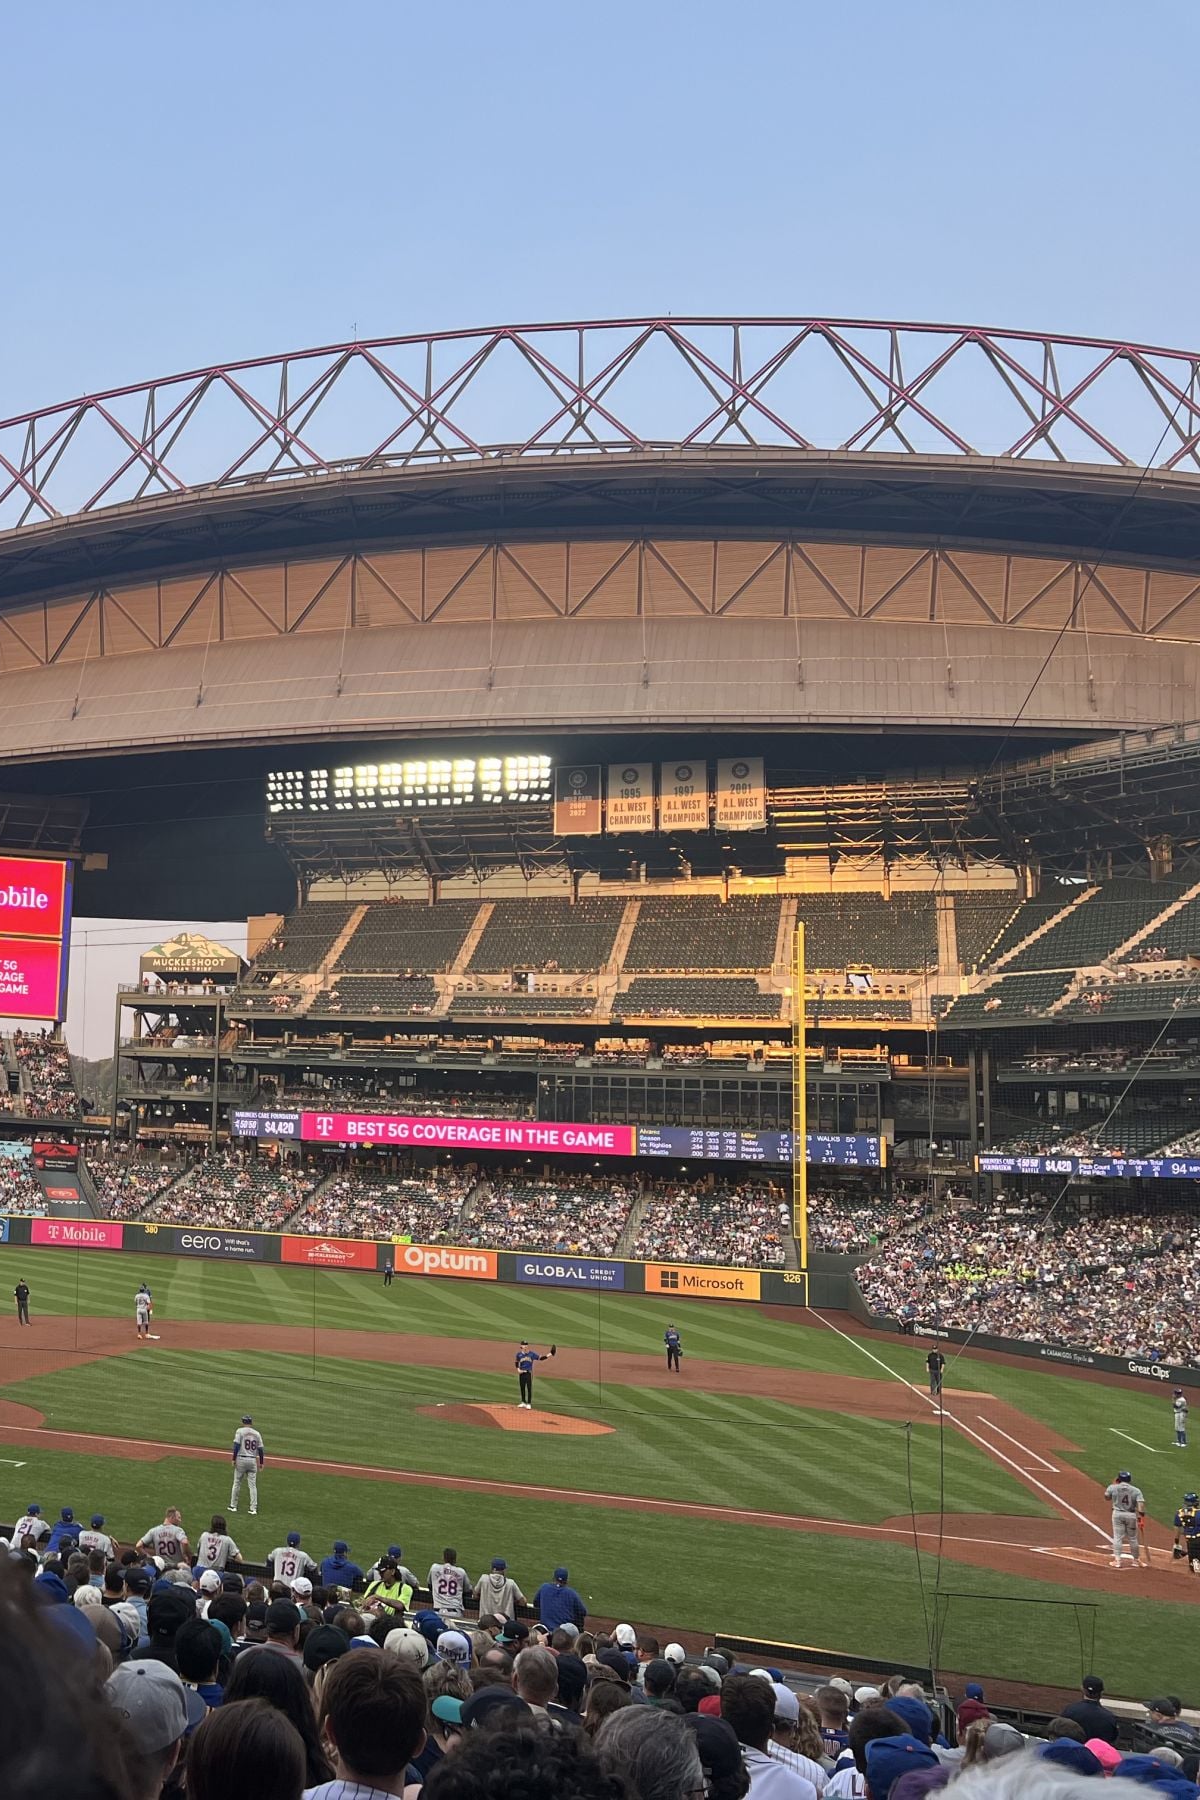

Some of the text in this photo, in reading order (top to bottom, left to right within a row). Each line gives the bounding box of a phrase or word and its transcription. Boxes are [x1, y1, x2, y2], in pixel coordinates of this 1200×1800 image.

[620, 788, 641, 799] 1995
[674, 786, 695, 798] 1997
[613, 802, 647, 812] A.L. WEST
[667, 799, 701, 810] A.L. WEST
[723, 797, 758, 808] A.L. WEST
[609, 814, 651, 825] CHAMPIONS
[662, 813, 706, 823] CHAMPIONS
[718, 810, 763, 821] CHAMPIONS
[2, 960, 17, 971] 5G
[152, 958, 226, 967] MUCKLESHOOT
[265, 1121, 294, 1134] $4,420
[348, 1121, 385, 1137] BEST
[388, 1122, 409, 1138] 5G
[412, 1124, 500, 1142] COVERAGE
[505, 1128, 523, 1143] IN
[526, 1129, 559, 1145] THE
[563, 1131, 614, 1148] GAME
[1045, 1160, 1072, 1172] $4,420
[1171, 1163, 1187, 1175] 94
[62, 1226, 106, 1241] Mobile
[145, 1225, 158, 1234] 380
[181, 1234, 221, 1250] eero
[404, 1246, 488, 1274] Optum
[524, 1264, 616, 1280] GLOBAL CREDIT
[590, 1273, 614, 1281] UNION
[783, 1272, 801, 1284] 326
[682, 1275, 744, 1292] Microsoft
[1128, 1362, 1170, 1379] Great Clips
[1121, 1494, 1129, 1506] 4
[17, 1523, 33, 1535] 21
[158, 1541, 176, 1556] 20
[207, 1546, 217, 1561] 3
[280, 1560, 295, 1577] 13
[438, 1579, 458, 1595] 28
